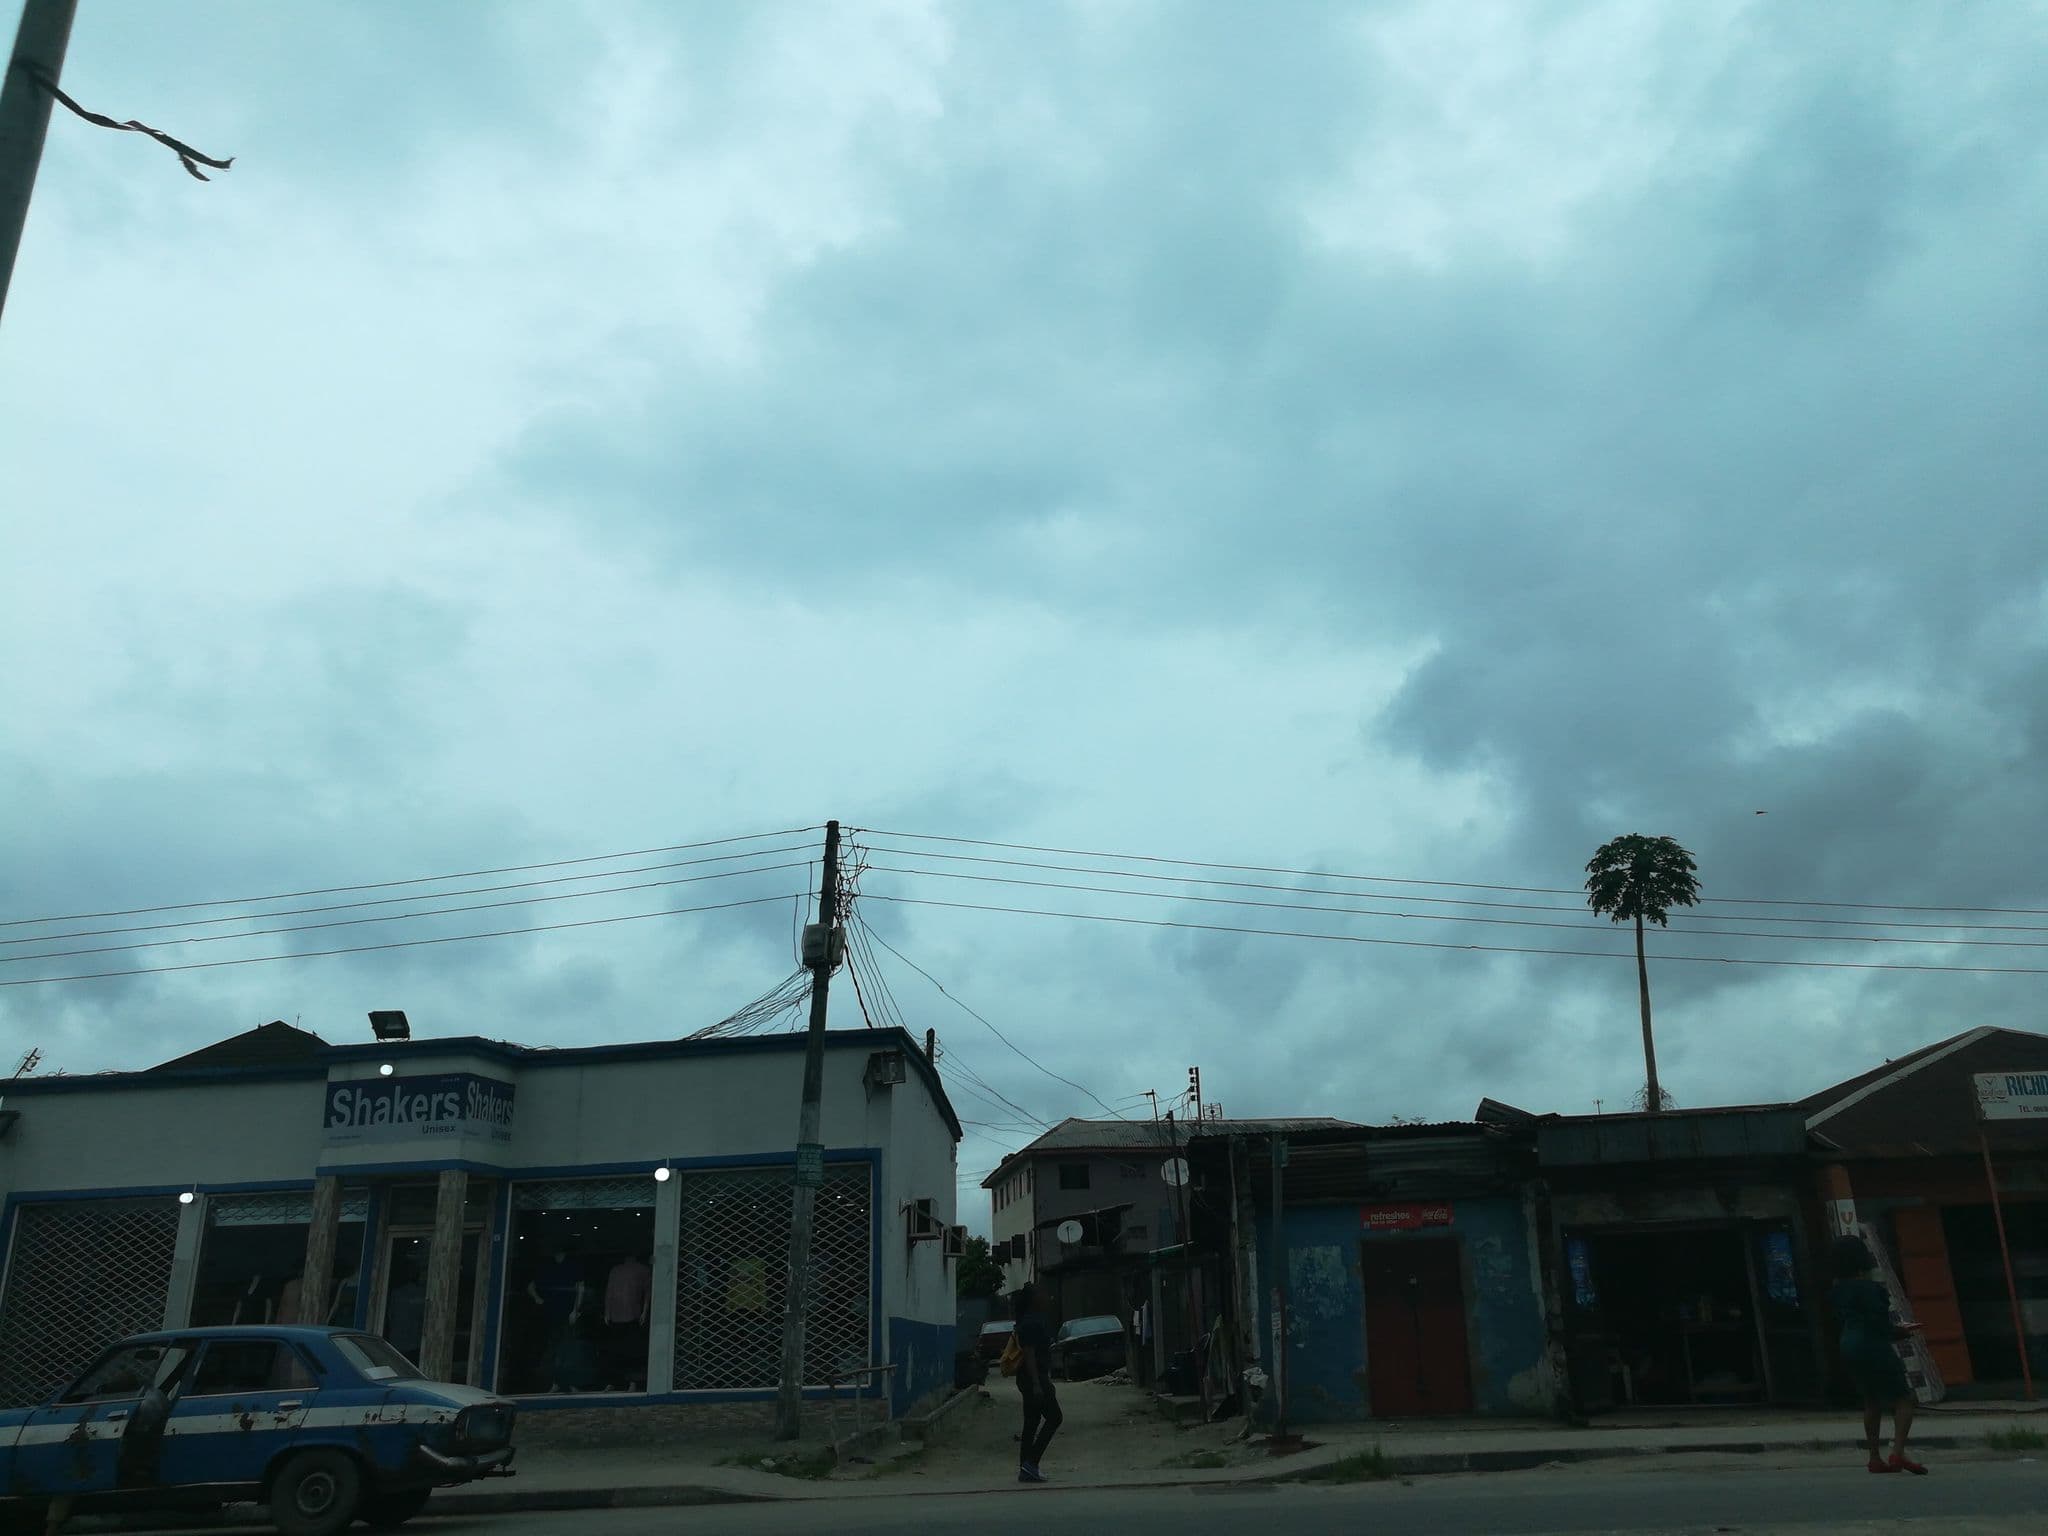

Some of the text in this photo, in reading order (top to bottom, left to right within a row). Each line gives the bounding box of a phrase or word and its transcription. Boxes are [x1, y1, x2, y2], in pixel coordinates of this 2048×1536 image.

[330, 1085, 460, 1127] Shakers
[466, 1080, 513, 1126] Shakers
[422, 1125, 456, 1135] Unisex
